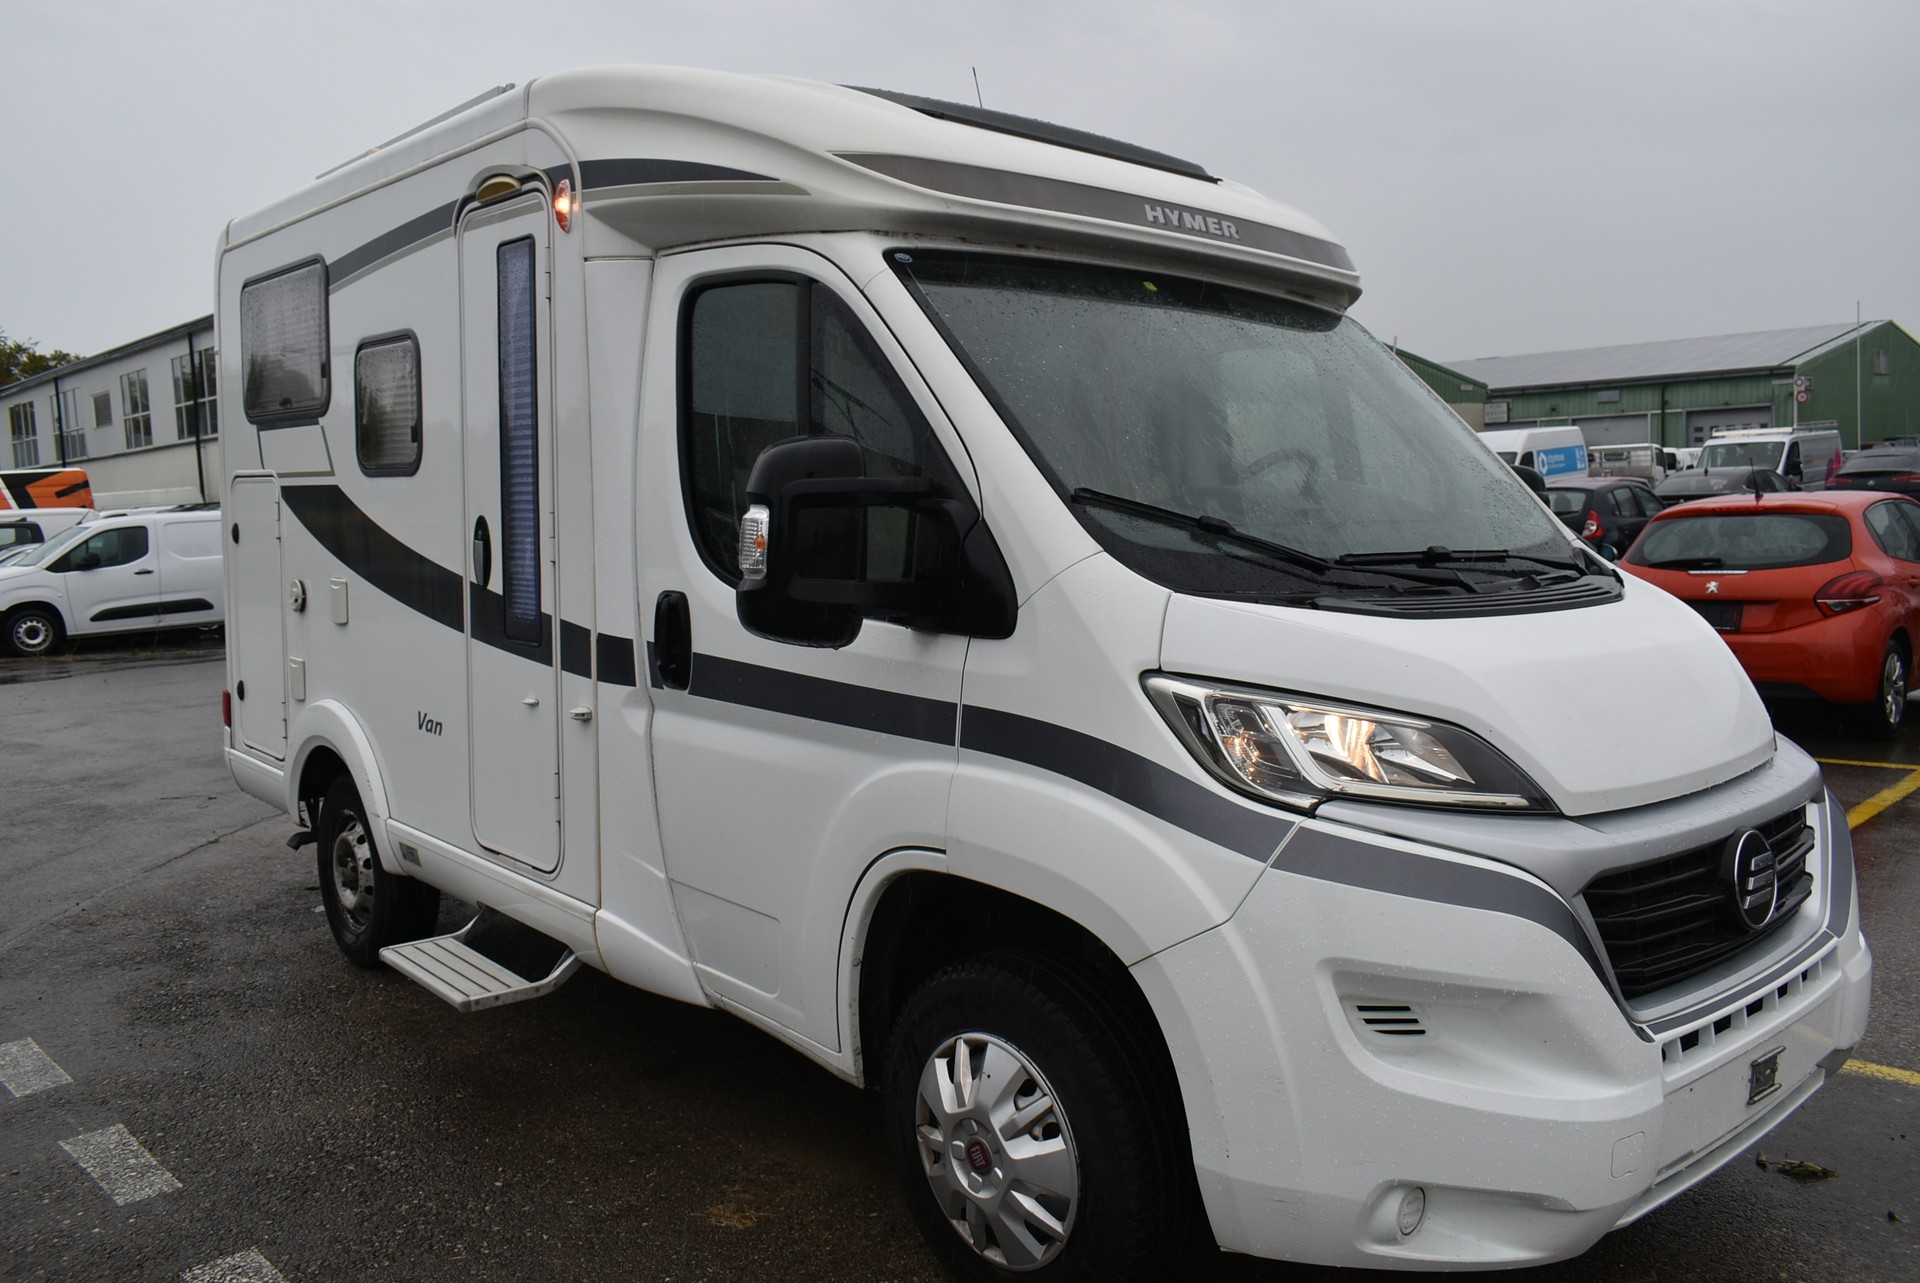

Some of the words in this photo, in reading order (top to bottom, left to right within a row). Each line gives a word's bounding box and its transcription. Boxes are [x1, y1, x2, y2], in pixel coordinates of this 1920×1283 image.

[1144, 204, 1240, 239] HYMER
[418, 710, 443, 736] Van
[969, 1145, 986, 1167] FIAT
